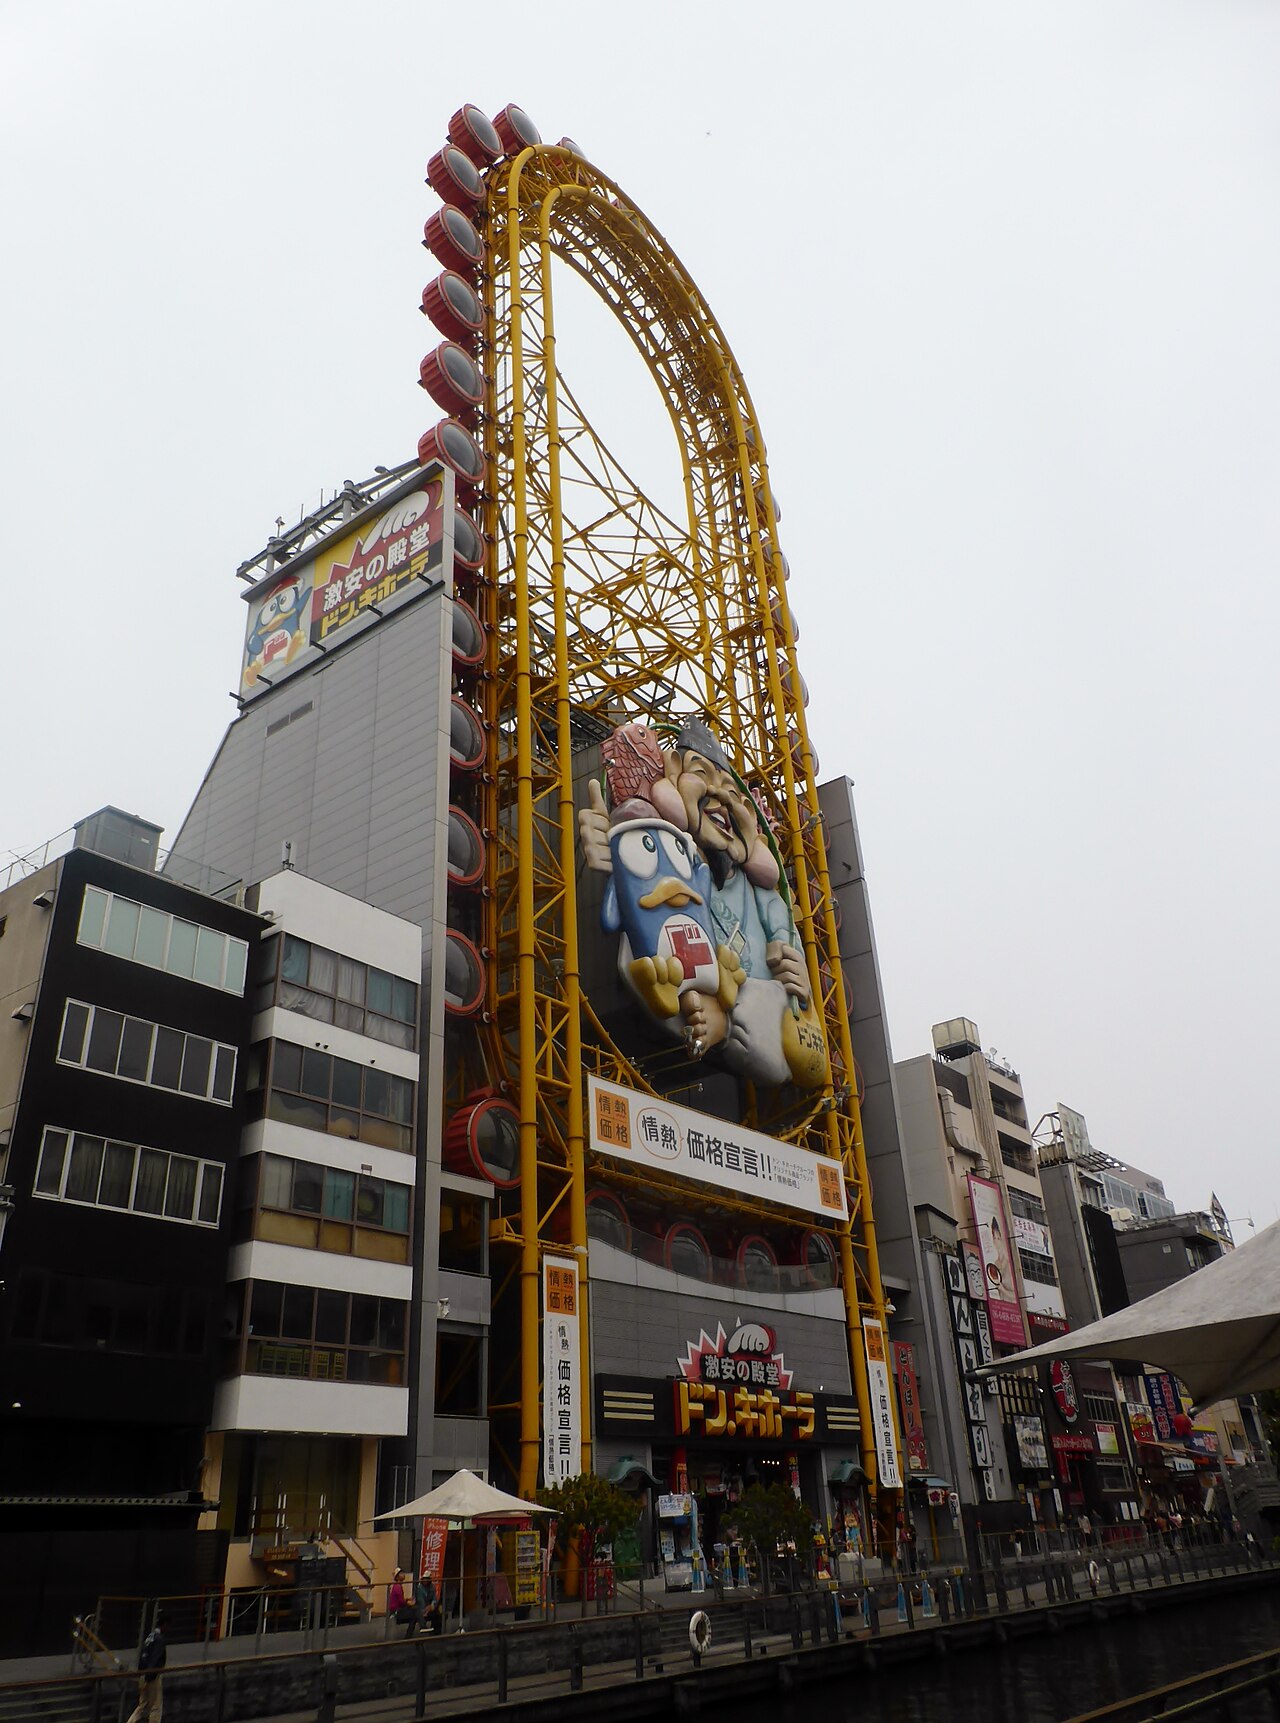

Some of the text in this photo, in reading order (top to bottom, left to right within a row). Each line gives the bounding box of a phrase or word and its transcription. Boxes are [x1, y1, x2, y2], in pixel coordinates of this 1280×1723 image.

[323, 522, 431, 612] 激安の殿堂
[599, 1095, 627, 1117] 情熱
[600, 1118, 628, 1143] 価格
[641, 1115, 678, 1152] 情熱
[549, 1269, 574, 1290] 情熱
[549, 1290, 574, 1312] 価格
[704, 1354, 780, 1386] 激安の殿堂
